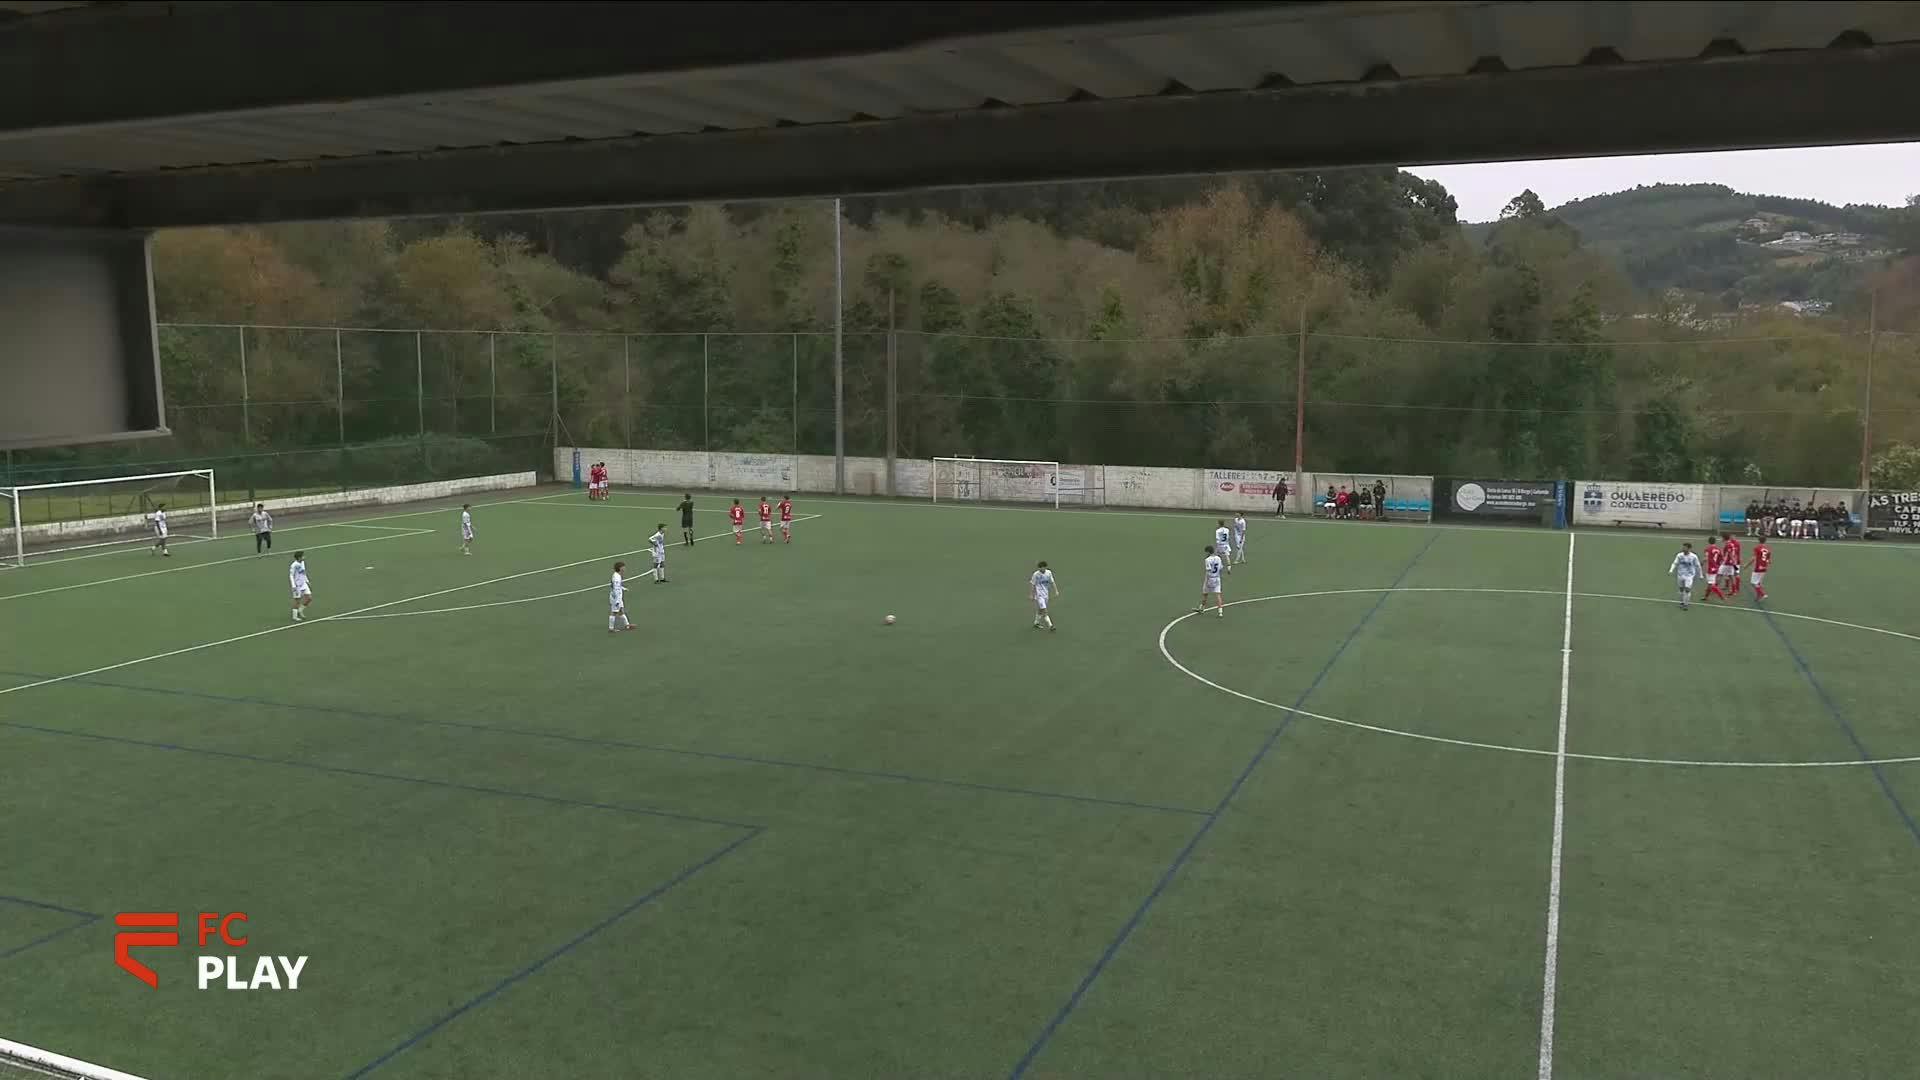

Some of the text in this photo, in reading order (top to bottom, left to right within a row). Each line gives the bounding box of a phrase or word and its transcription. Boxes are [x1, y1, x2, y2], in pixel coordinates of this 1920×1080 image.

[1610, 501, 1667, 510] CONCELLO
[1221, 533, 1228, 542] 3
[1212, 563, 1219, 574] 5
